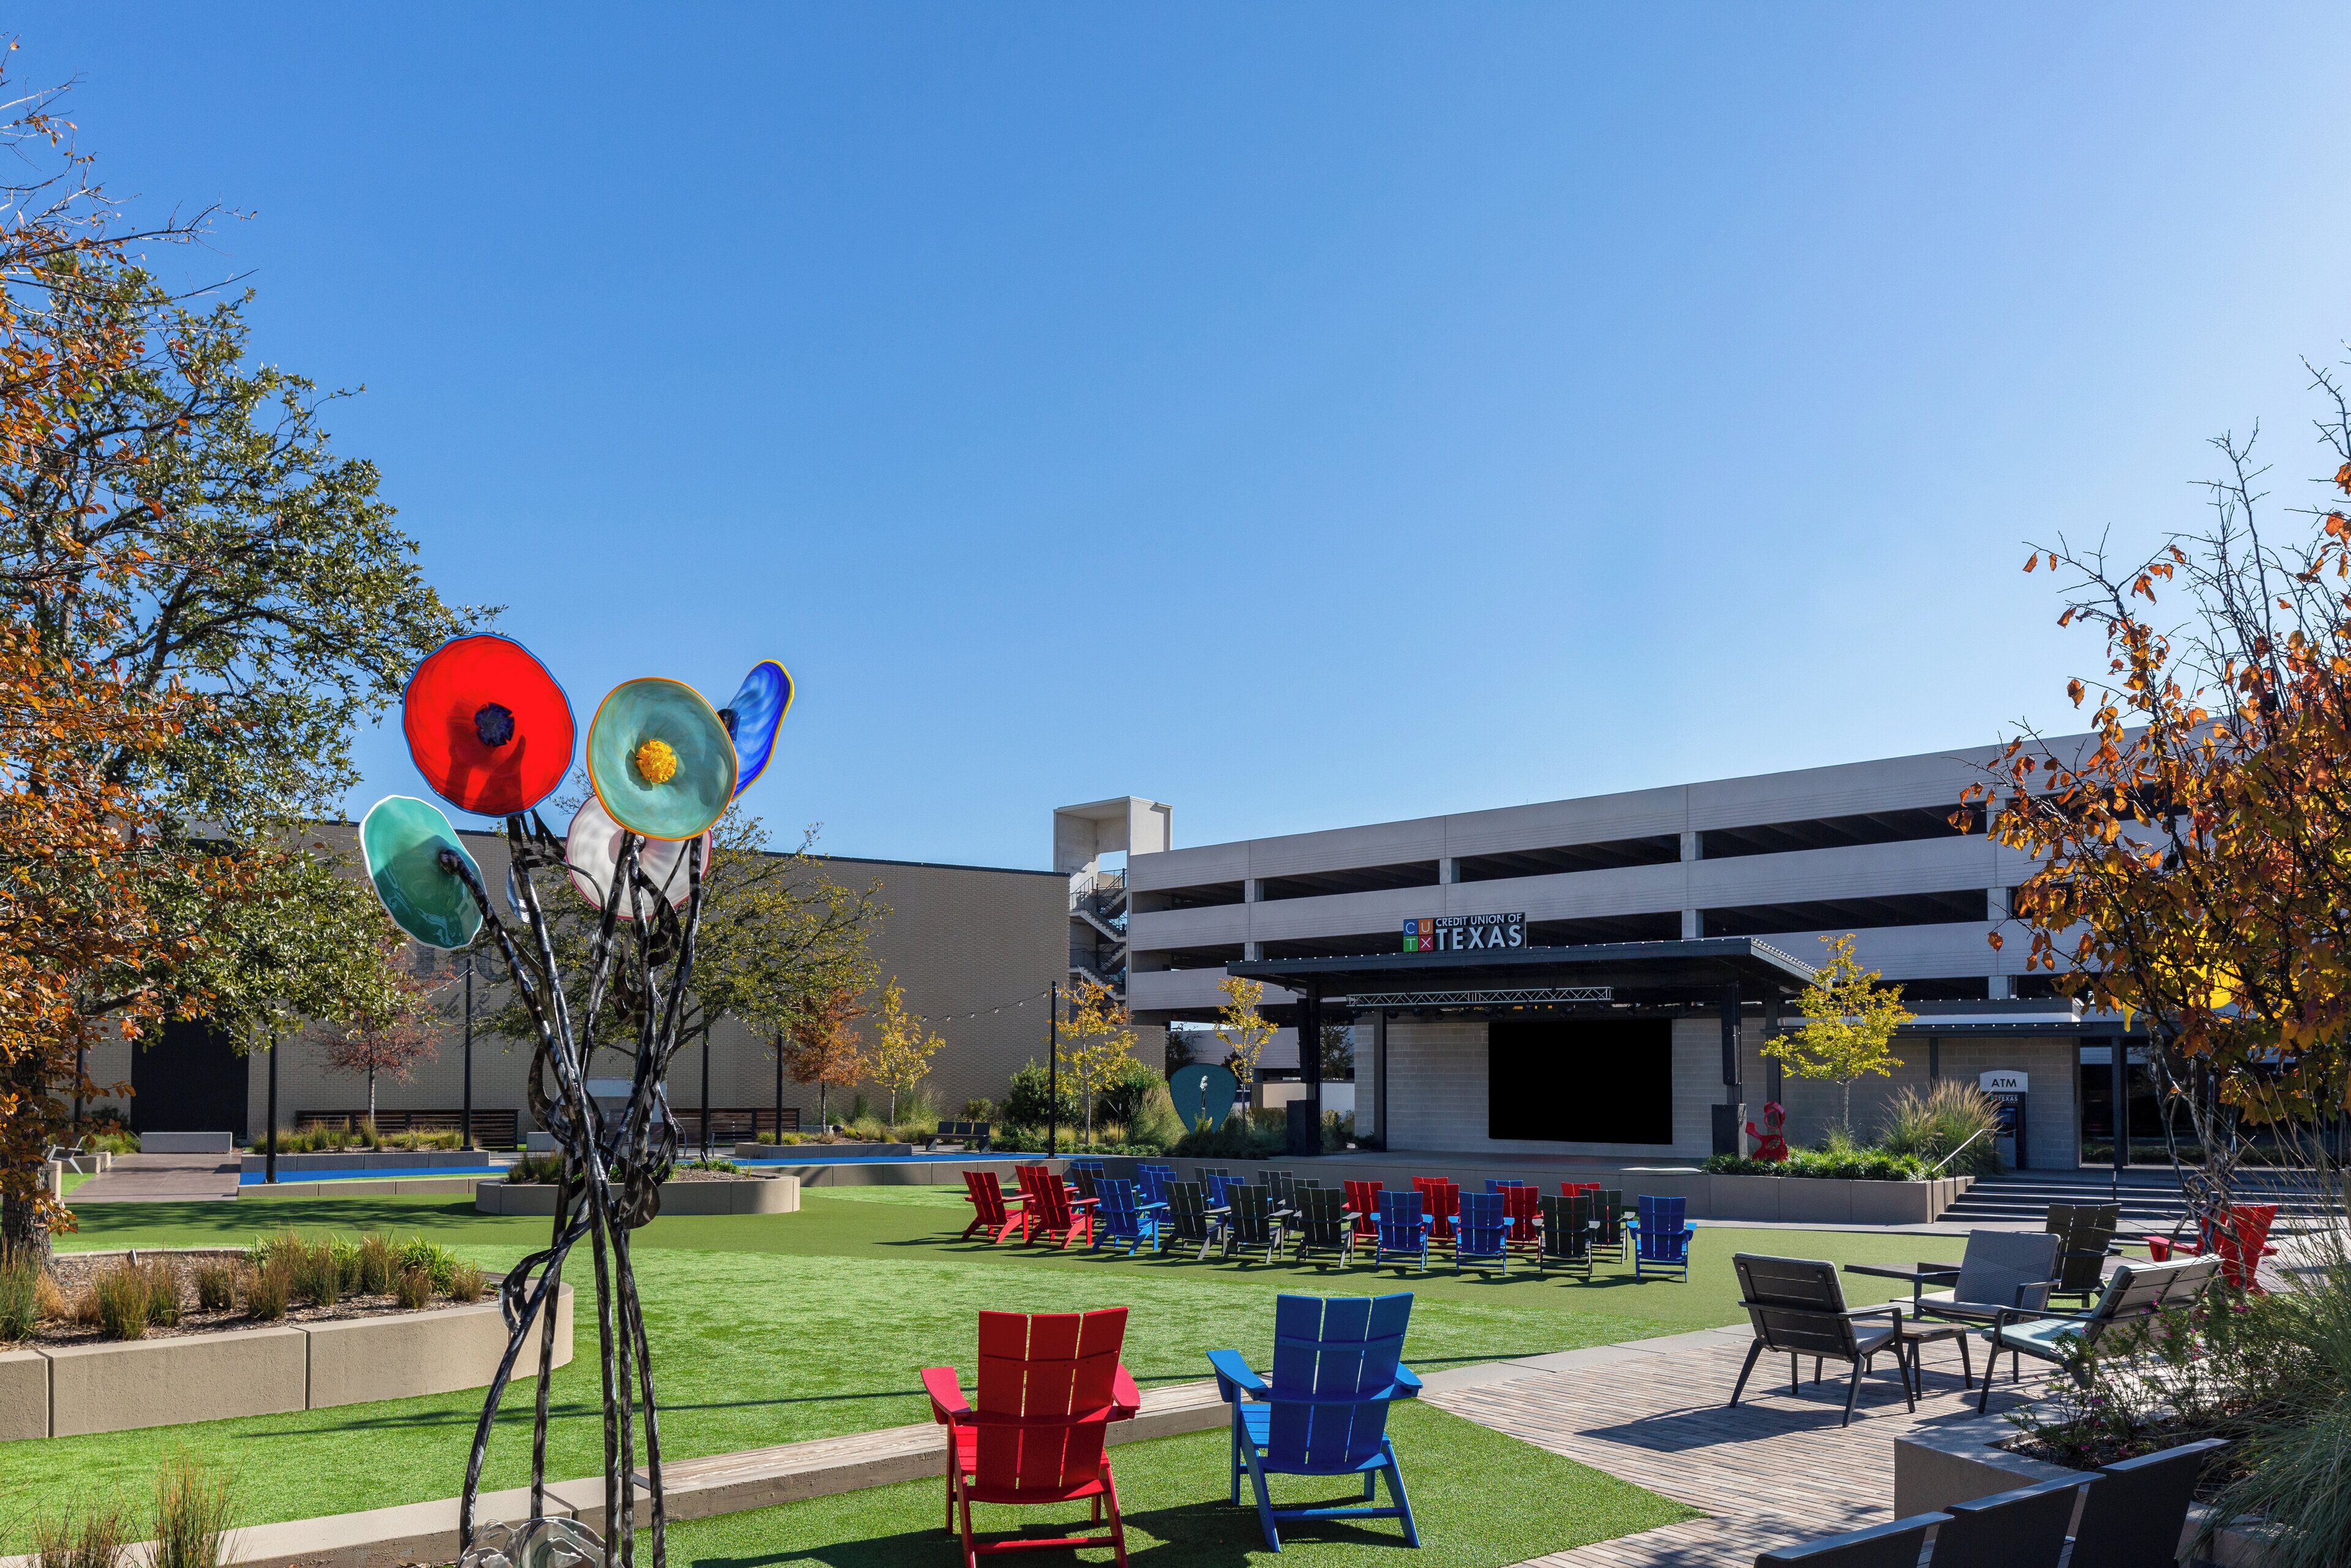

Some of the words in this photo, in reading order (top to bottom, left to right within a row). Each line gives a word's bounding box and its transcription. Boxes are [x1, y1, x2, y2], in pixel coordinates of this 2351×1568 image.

[1436, 916, 1468, 927] CREDIT
[1471, 914, 1504, 925] UNION
[1508, 913, 1523, 923] OF
[1435, 925, 1521, 950] TEXAS
[1991, 1078, 2017, 1087] ATM
